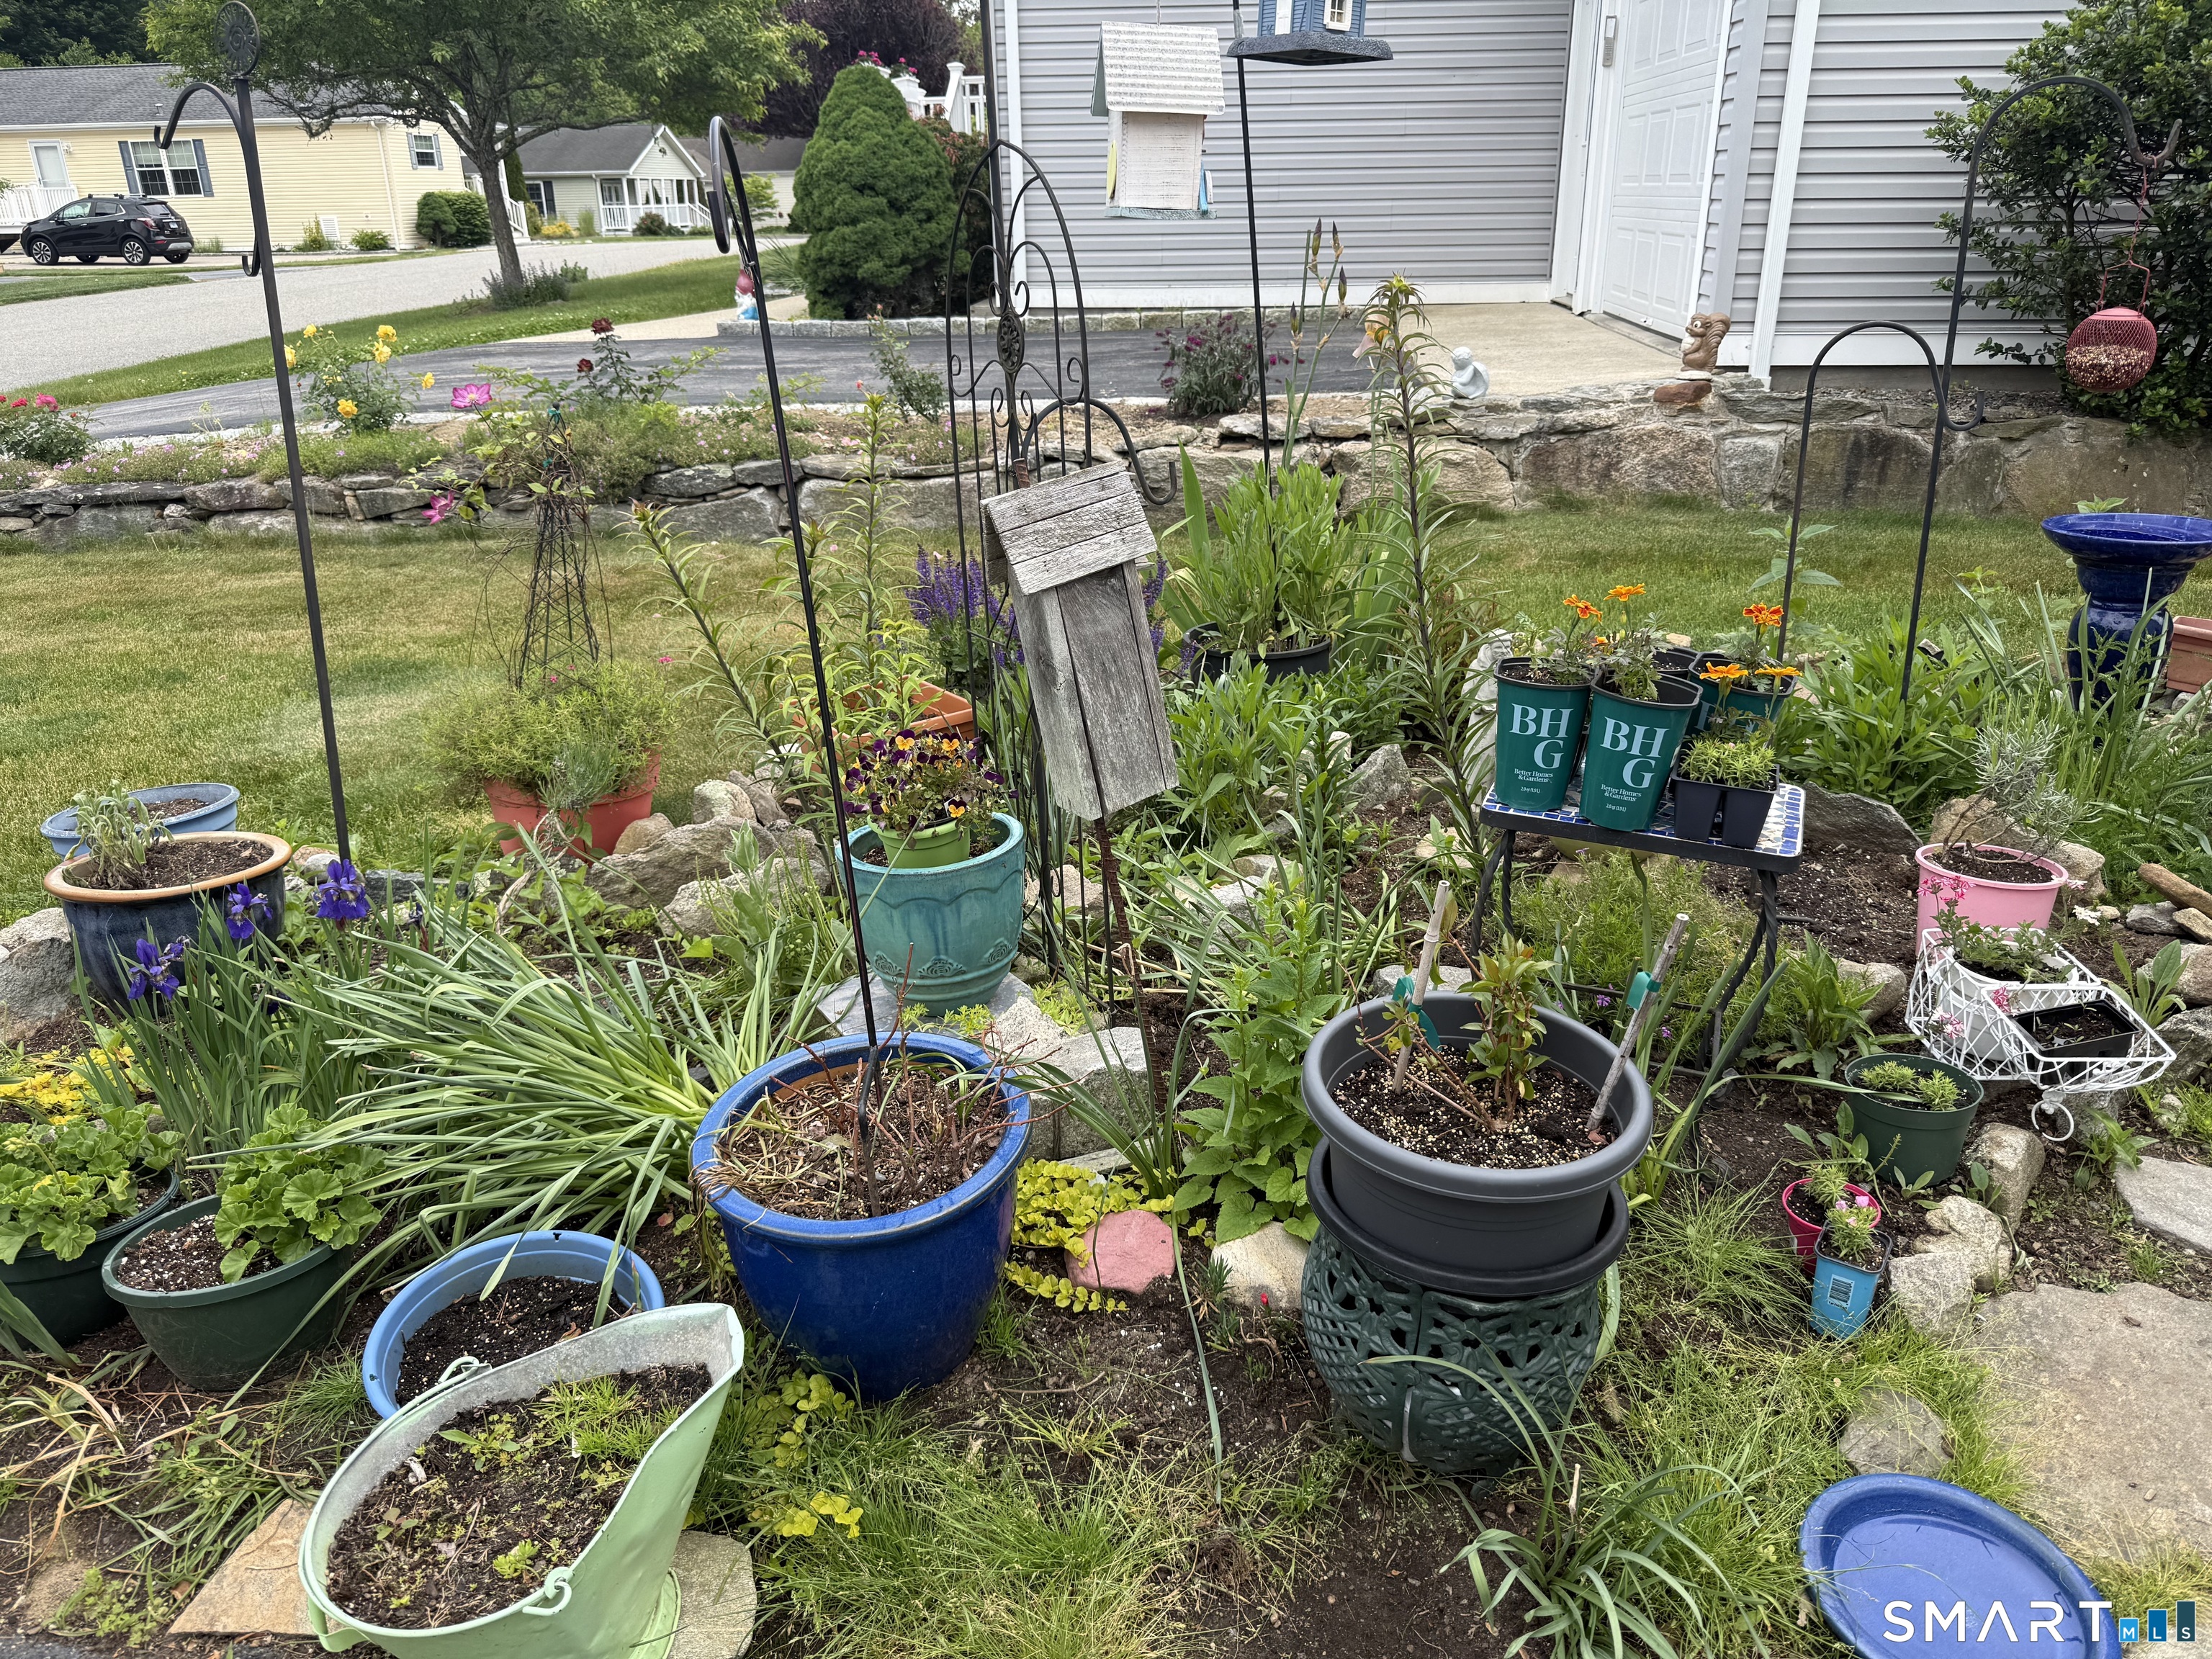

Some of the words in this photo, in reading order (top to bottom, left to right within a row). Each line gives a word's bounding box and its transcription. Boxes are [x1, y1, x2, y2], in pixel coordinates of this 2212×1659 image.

[1509, 703, 1574, 738] BH
[1599, 716, 1671, 758] BH
[1534, 739, 1565, 769] G
[1622, 758, 1655, 788] G
[1601, 783, 1619, 793] Better
[1619, 788, 1642, 797] Homes
